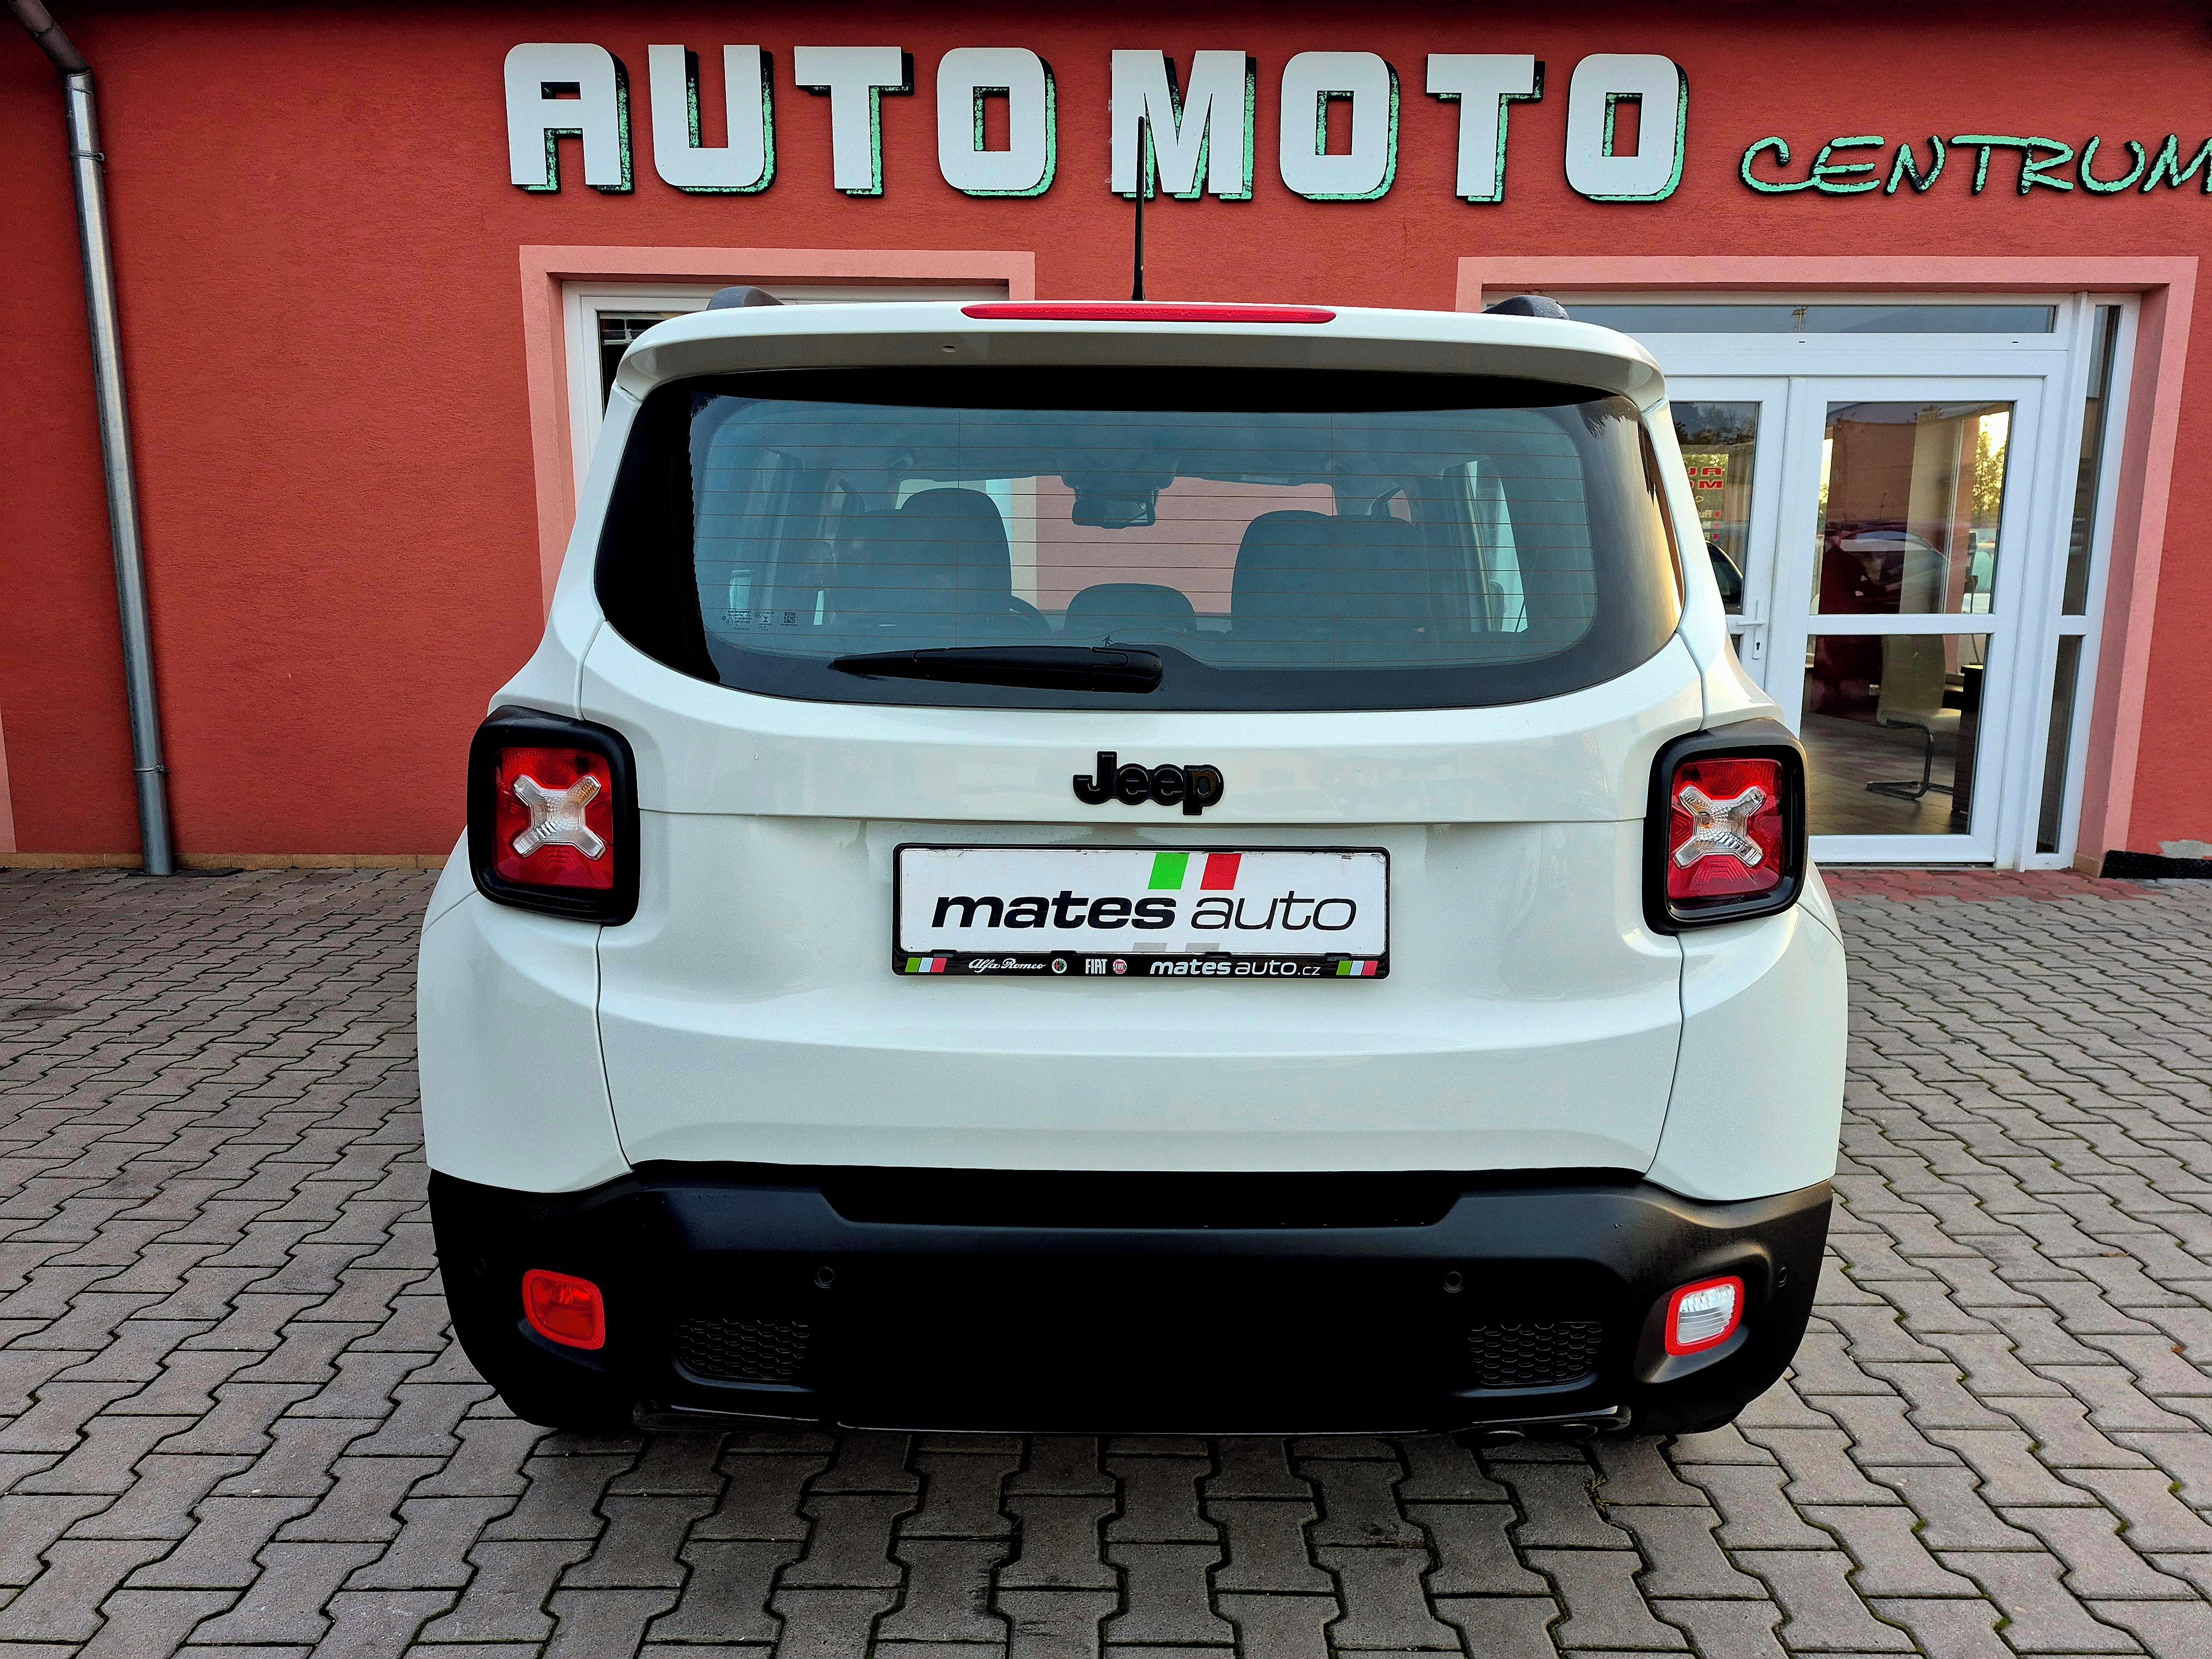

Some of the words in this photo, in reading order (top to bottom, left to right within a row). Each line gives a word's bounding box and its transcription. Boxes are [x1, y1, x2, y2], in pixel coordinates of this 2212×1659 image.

[504, 43, 1057, 199] AUTO
[1111, 49, 1688, 205] MOTO
[1738, 134, 2212, 196] CENTRUM
[1073, 750, 1224, 816] Jeep
[931, 890, 1177, 930] mates
[1190, 890, 1357, 931] auto
[968, 958, 1000, 973] Alfa
[1000, 958, 1046, 969] Romeo
[1085, 958, 1108, 974] FIAT
[1115, 962, 1124, 971] FIAT
